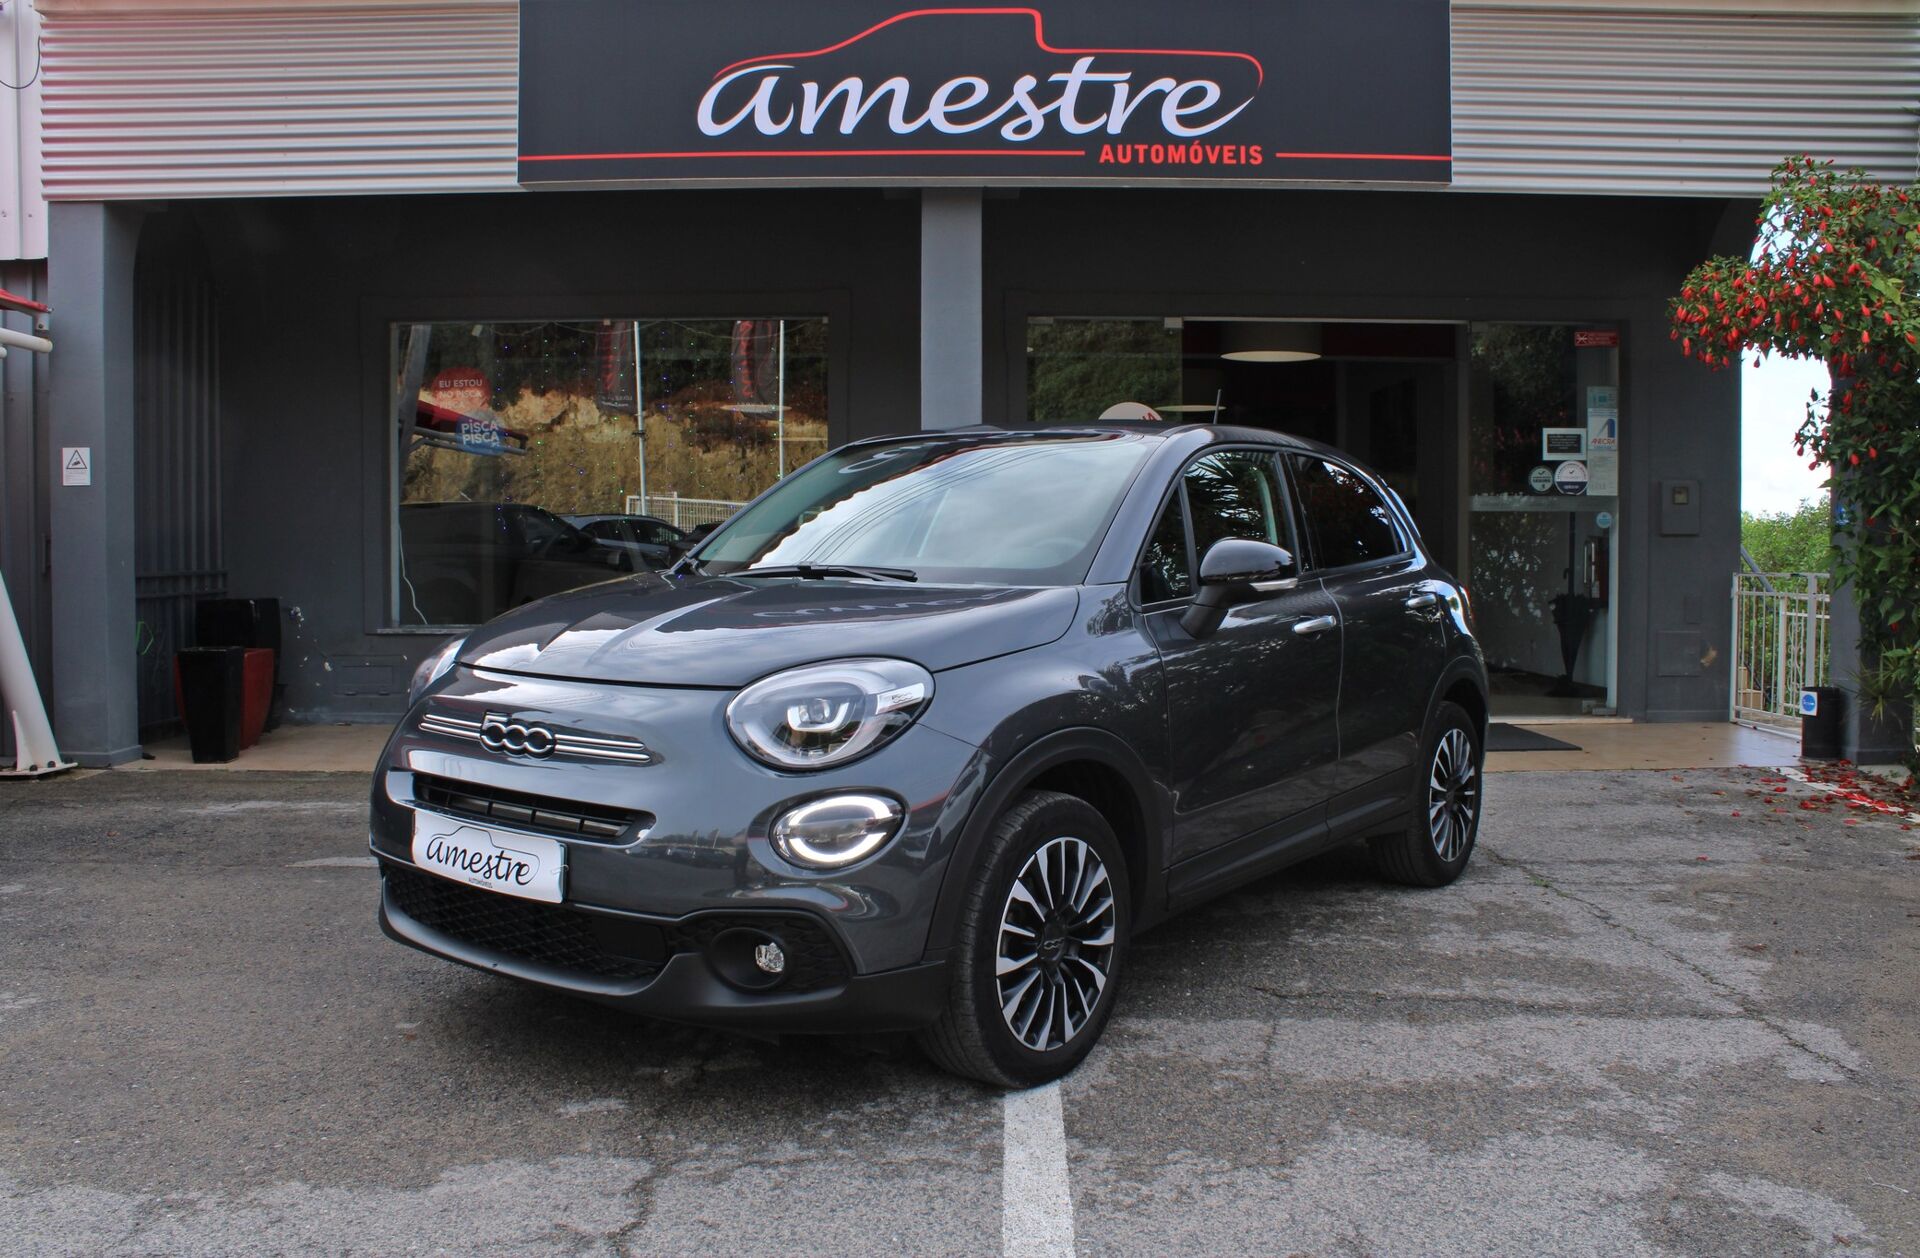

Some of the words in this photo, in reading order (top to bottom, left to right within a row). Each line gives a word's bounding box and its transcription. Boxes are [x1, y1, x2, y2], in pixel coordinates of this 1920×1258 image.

[697, 56, 1255, 141] amestre
[1099, 140, 1263, 165] AUTOMÓVEIS
[439, 380, 451, 388] EU
[453, 379, 483, 387] ESTOU
[462, 431, 500, 445] PISCA
[480, 713, 553, 755] 500
[426, 836, 531, 886] amestre
